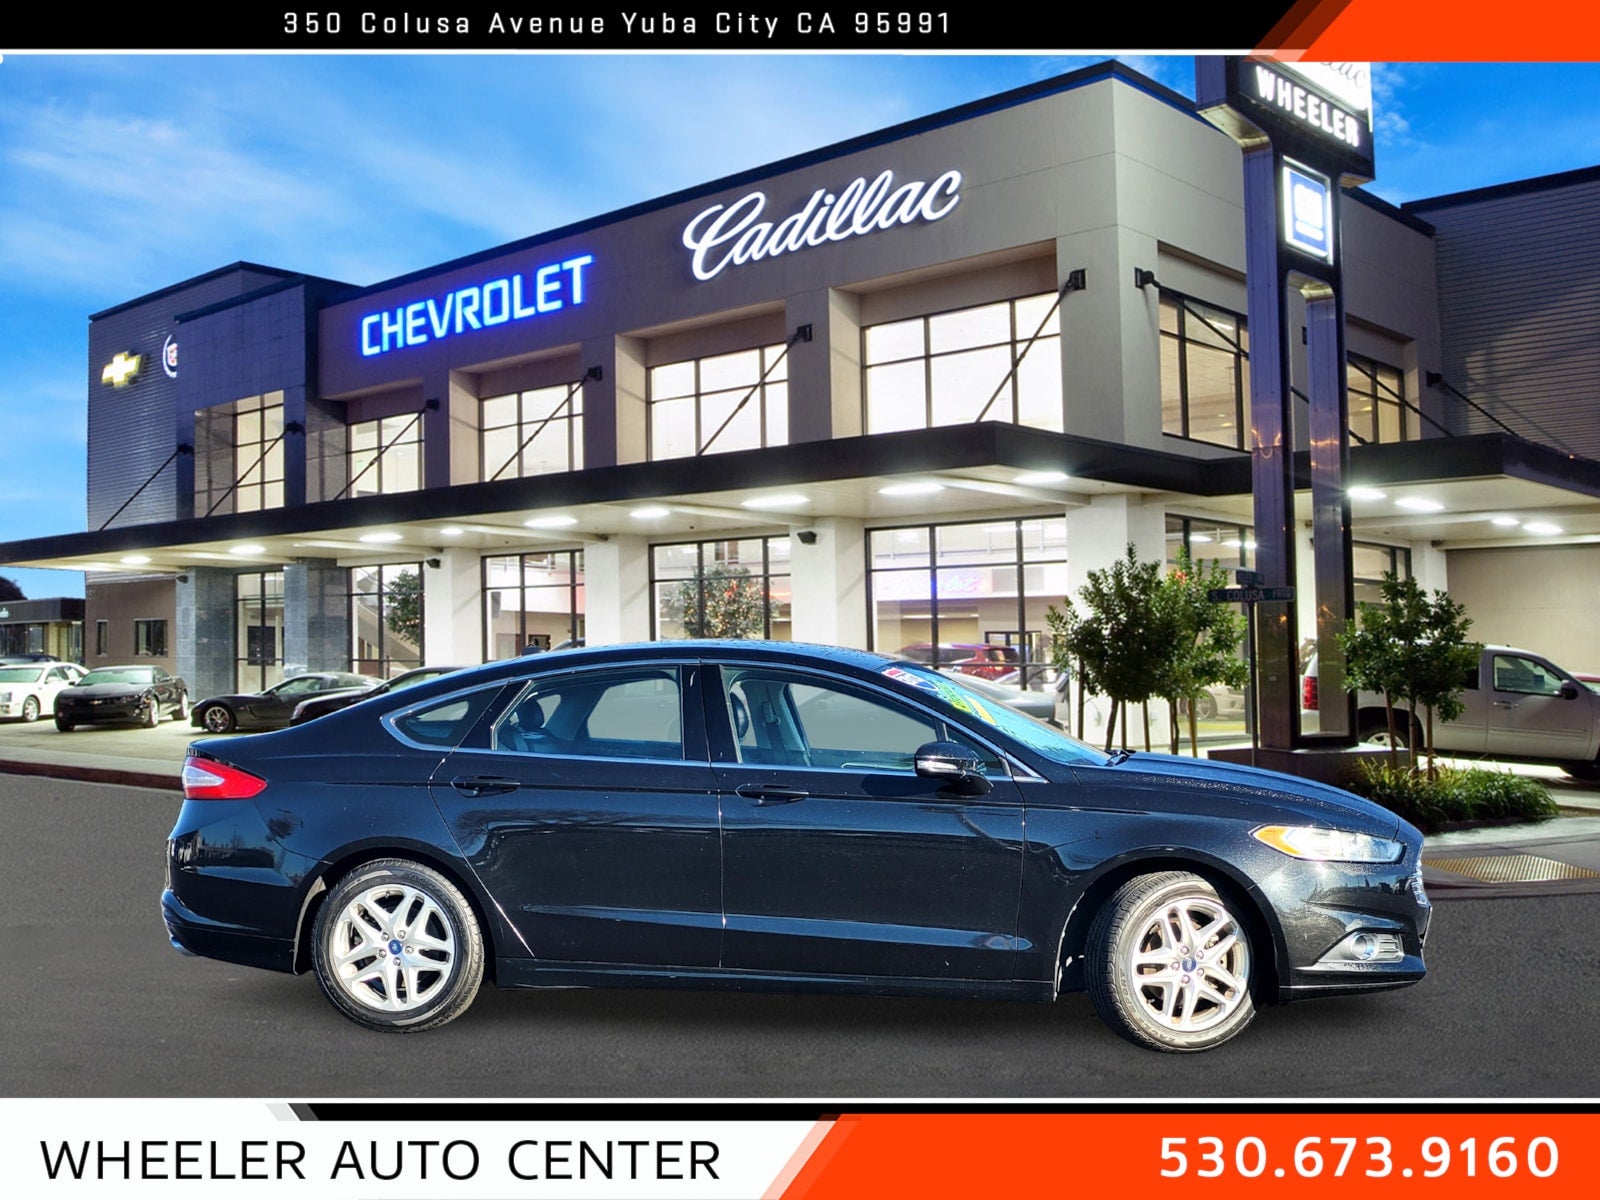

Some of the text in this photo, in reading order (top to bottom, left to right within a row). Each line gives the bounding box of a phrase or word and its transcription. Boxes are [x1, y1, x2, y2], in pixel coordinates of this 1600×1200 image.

[1256, 65, 1360, 148] WHEELER
[682, 169, 962, 281] Cadillac
[361, 255, 594, 356] CHEVROLET
[1226, 589, 1265, 601] COLUSA
